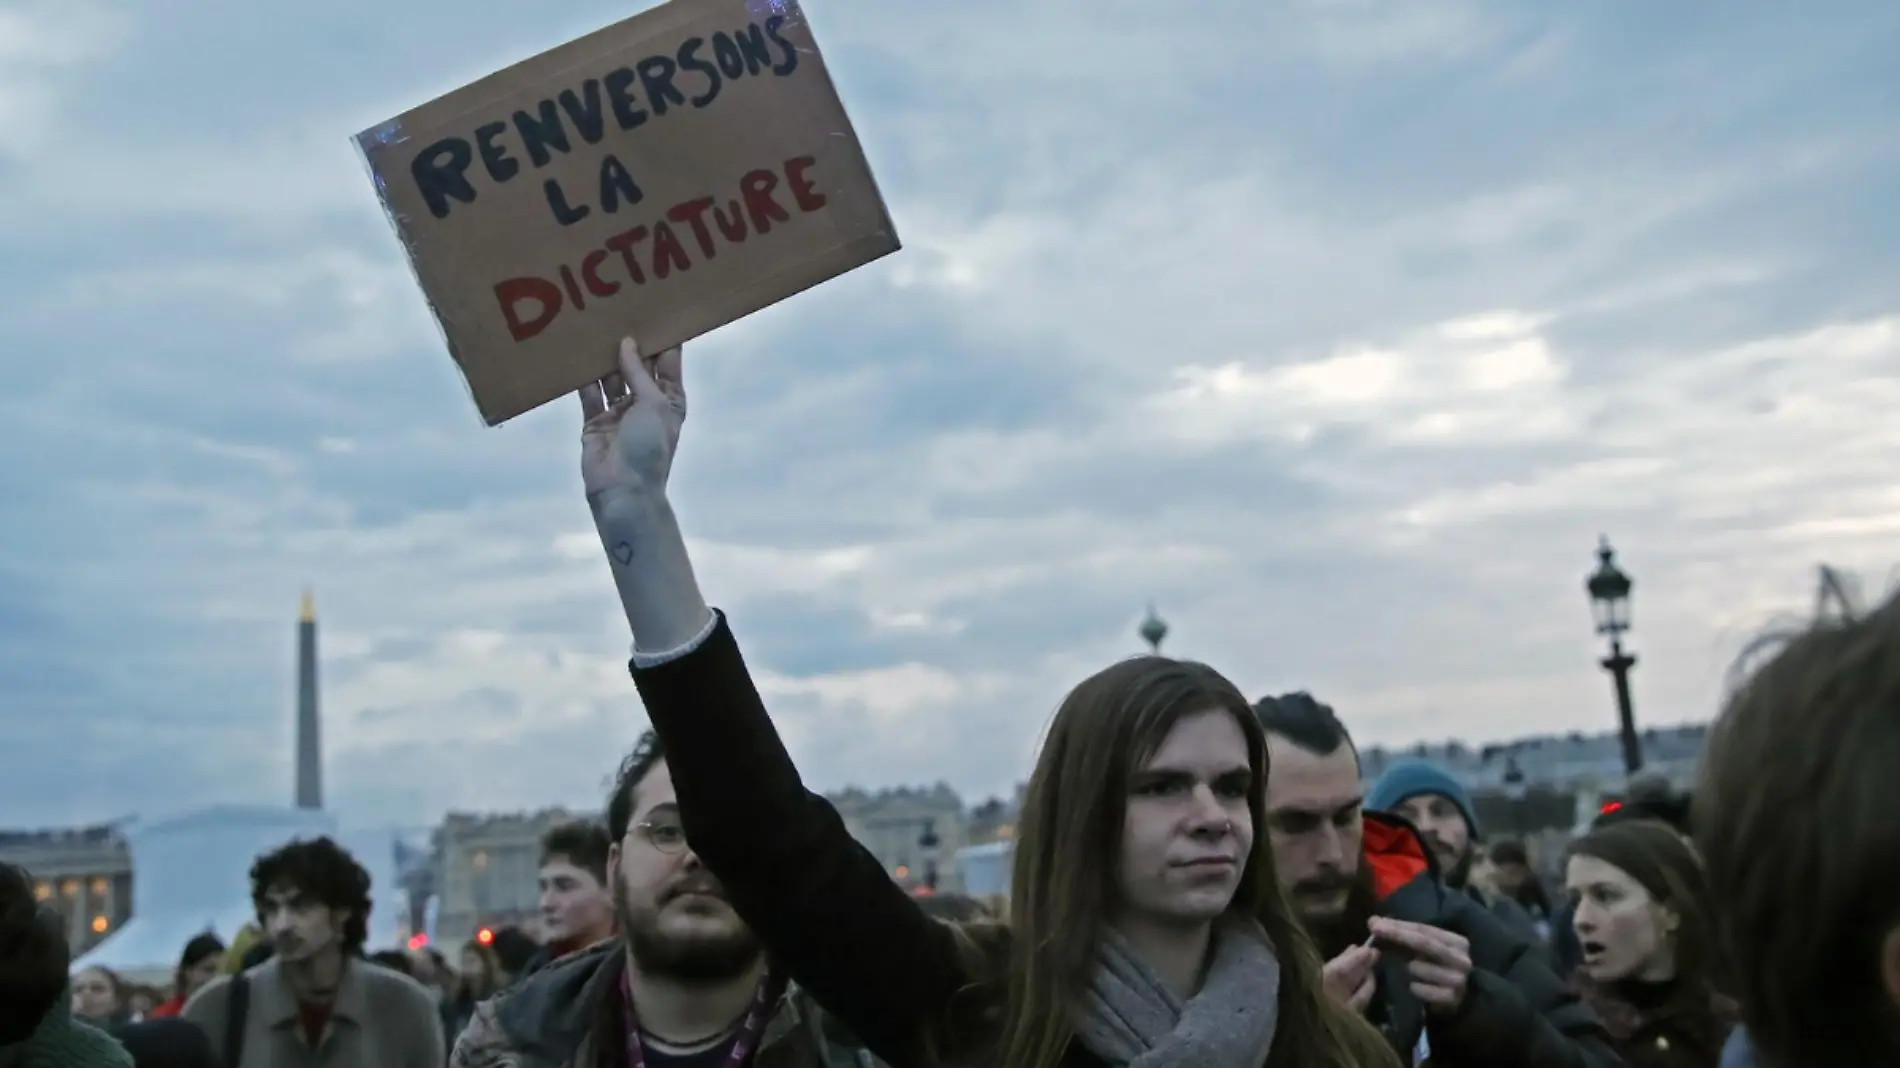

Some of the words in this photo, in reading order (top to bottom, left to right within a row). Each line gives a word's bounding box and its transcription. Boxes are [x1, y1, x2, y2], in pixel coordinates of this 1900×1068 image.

[411, 16, 798, 218] RENVERSONS
[543, 155, 643, 225] LA
[493, 156, 826, 342] DICTATURE
